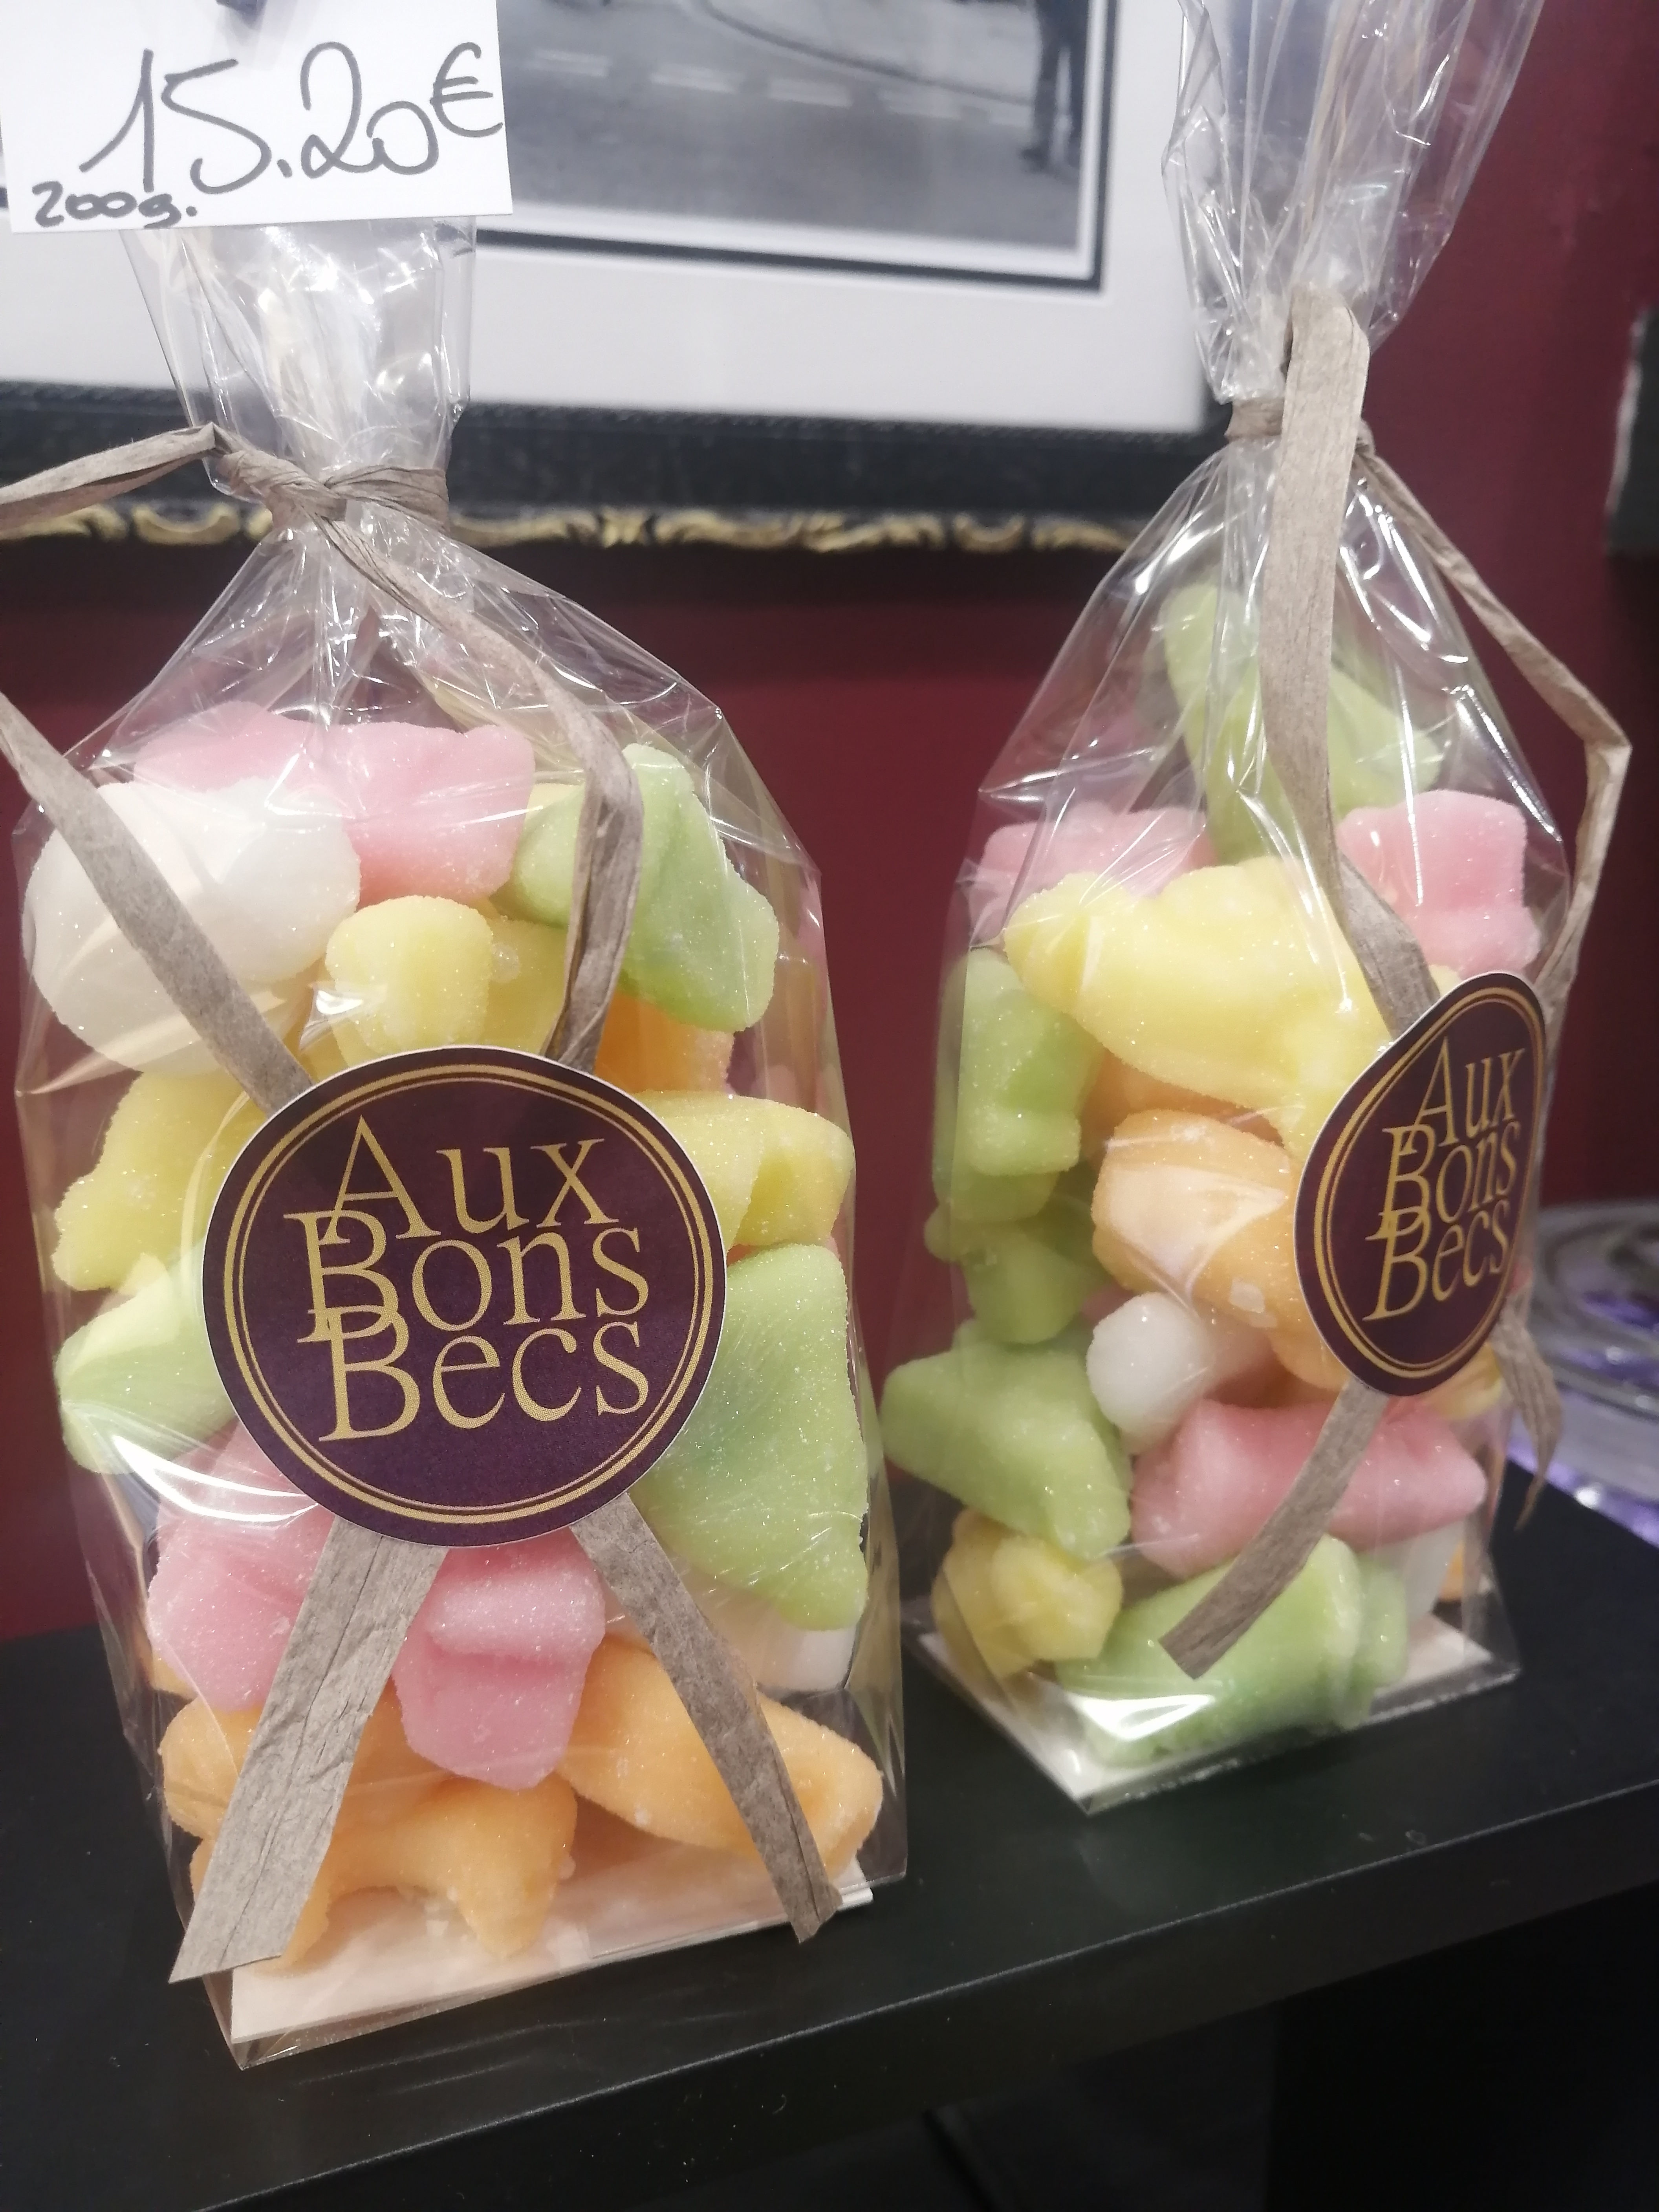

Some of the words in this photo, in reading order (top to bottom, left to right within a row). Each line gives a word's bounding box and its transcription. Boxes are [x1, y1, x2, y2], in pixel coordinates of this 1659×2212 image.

[1398, 1035, 1525, 1155] Aux
[317, 1114, 619, 1245] Aux
[1364, 1120, 1521, 1241] Bons
[283, 1209, 649, 1343] Bons
[1362, 1199, 1511, 1321] Becs
[307, 1304, 649, 1443] Becs
